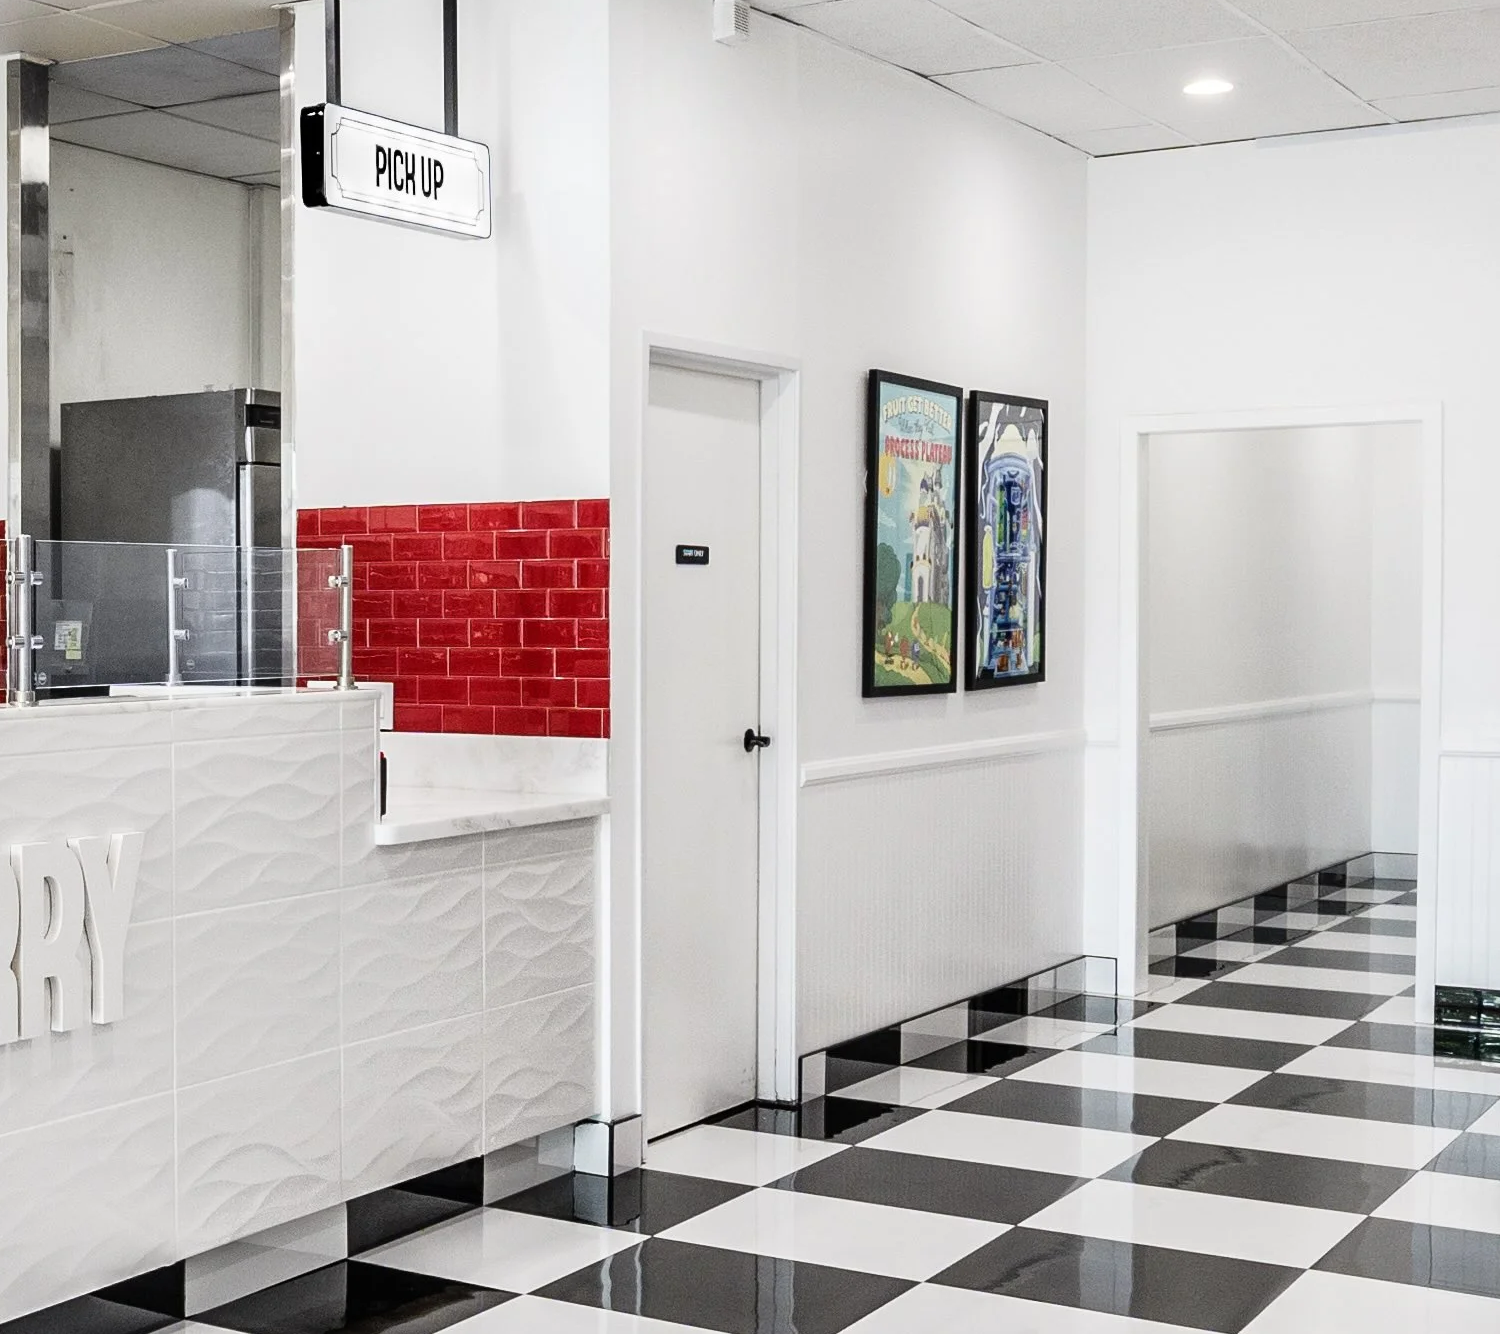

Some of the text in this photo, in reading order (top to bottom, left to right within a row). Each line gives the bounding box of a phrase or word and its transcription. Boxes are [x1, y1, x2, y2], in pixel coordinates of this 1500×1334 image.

[376, 144, 444, 200] PICK UP
[883, 397, 906, 423] FRUIT
[906, 395, 923, 414] GET
[923, 397, 952, 430] BETTER
[885, 435, 953, 465] PROCESS PLATEAU
